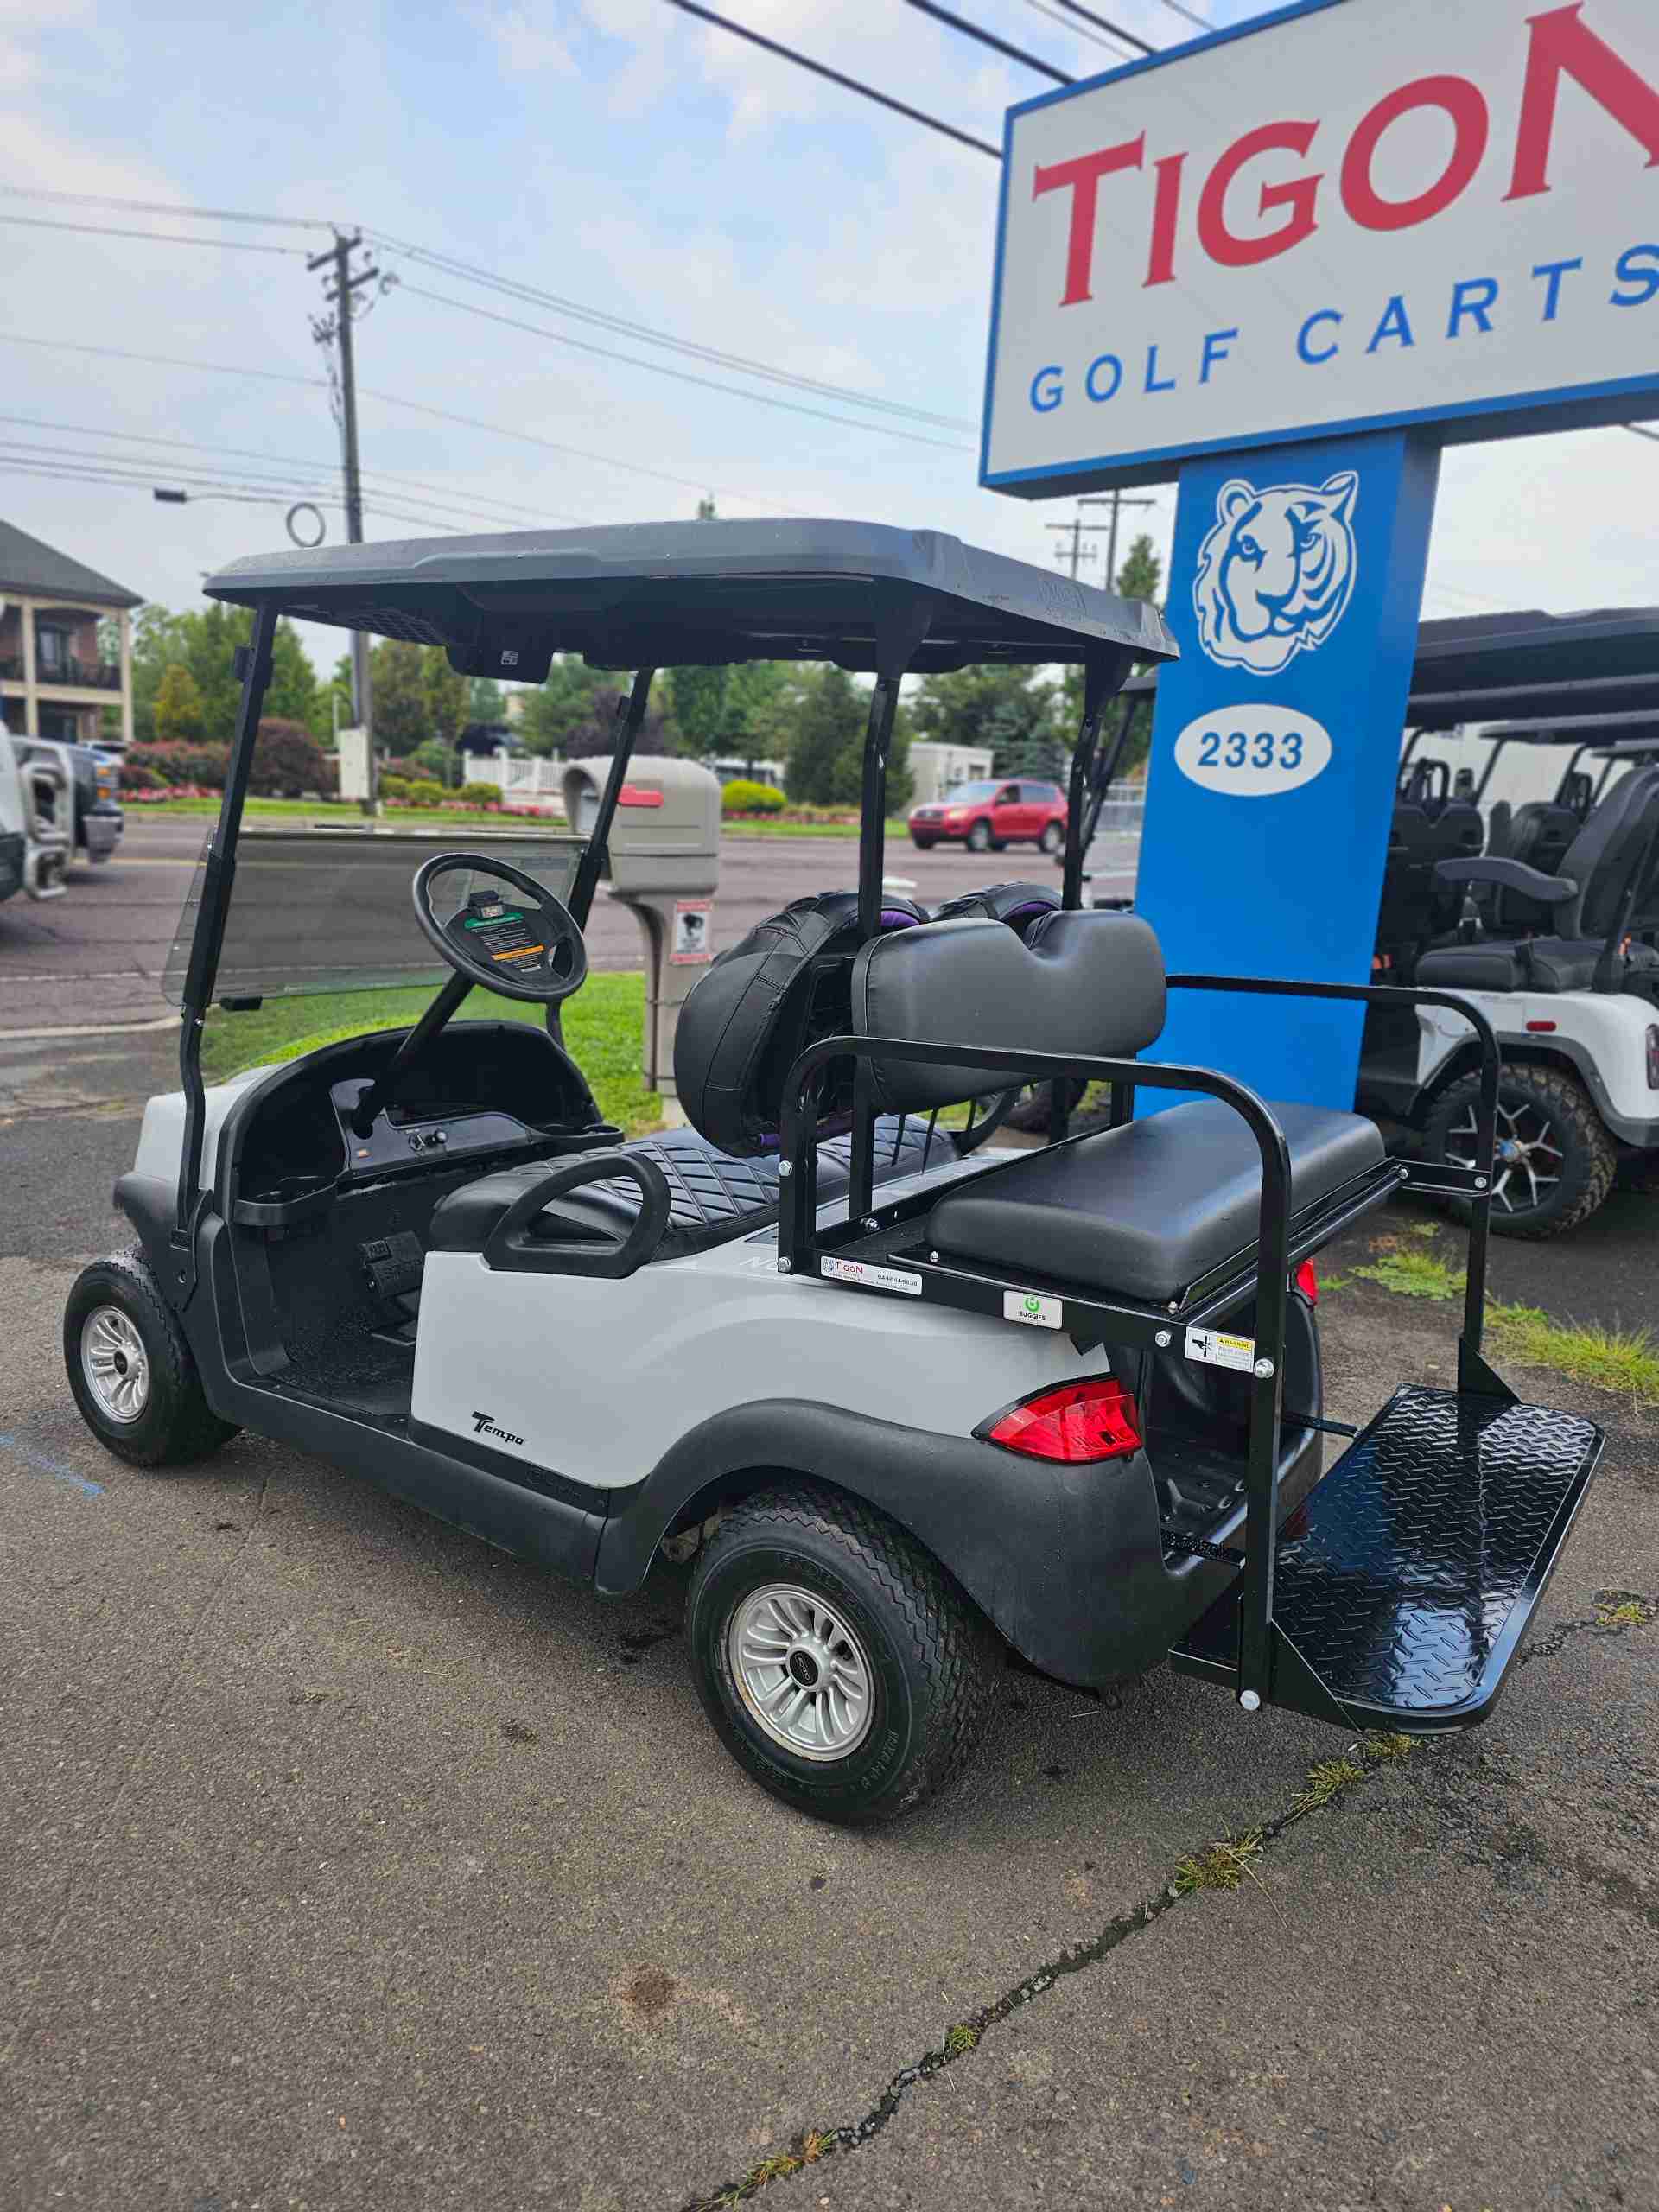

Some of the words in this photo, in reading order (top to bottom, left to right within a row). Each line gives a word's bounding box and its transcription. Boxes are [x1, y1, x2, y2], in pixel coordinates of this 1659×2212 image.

[1029, 328, 1238, 413] GOLF
[1295, 245, 1659, 365] CARTS
[1198, 732, 1303, 770] 2333
[471, 1410, 524, 1446] Tempo
